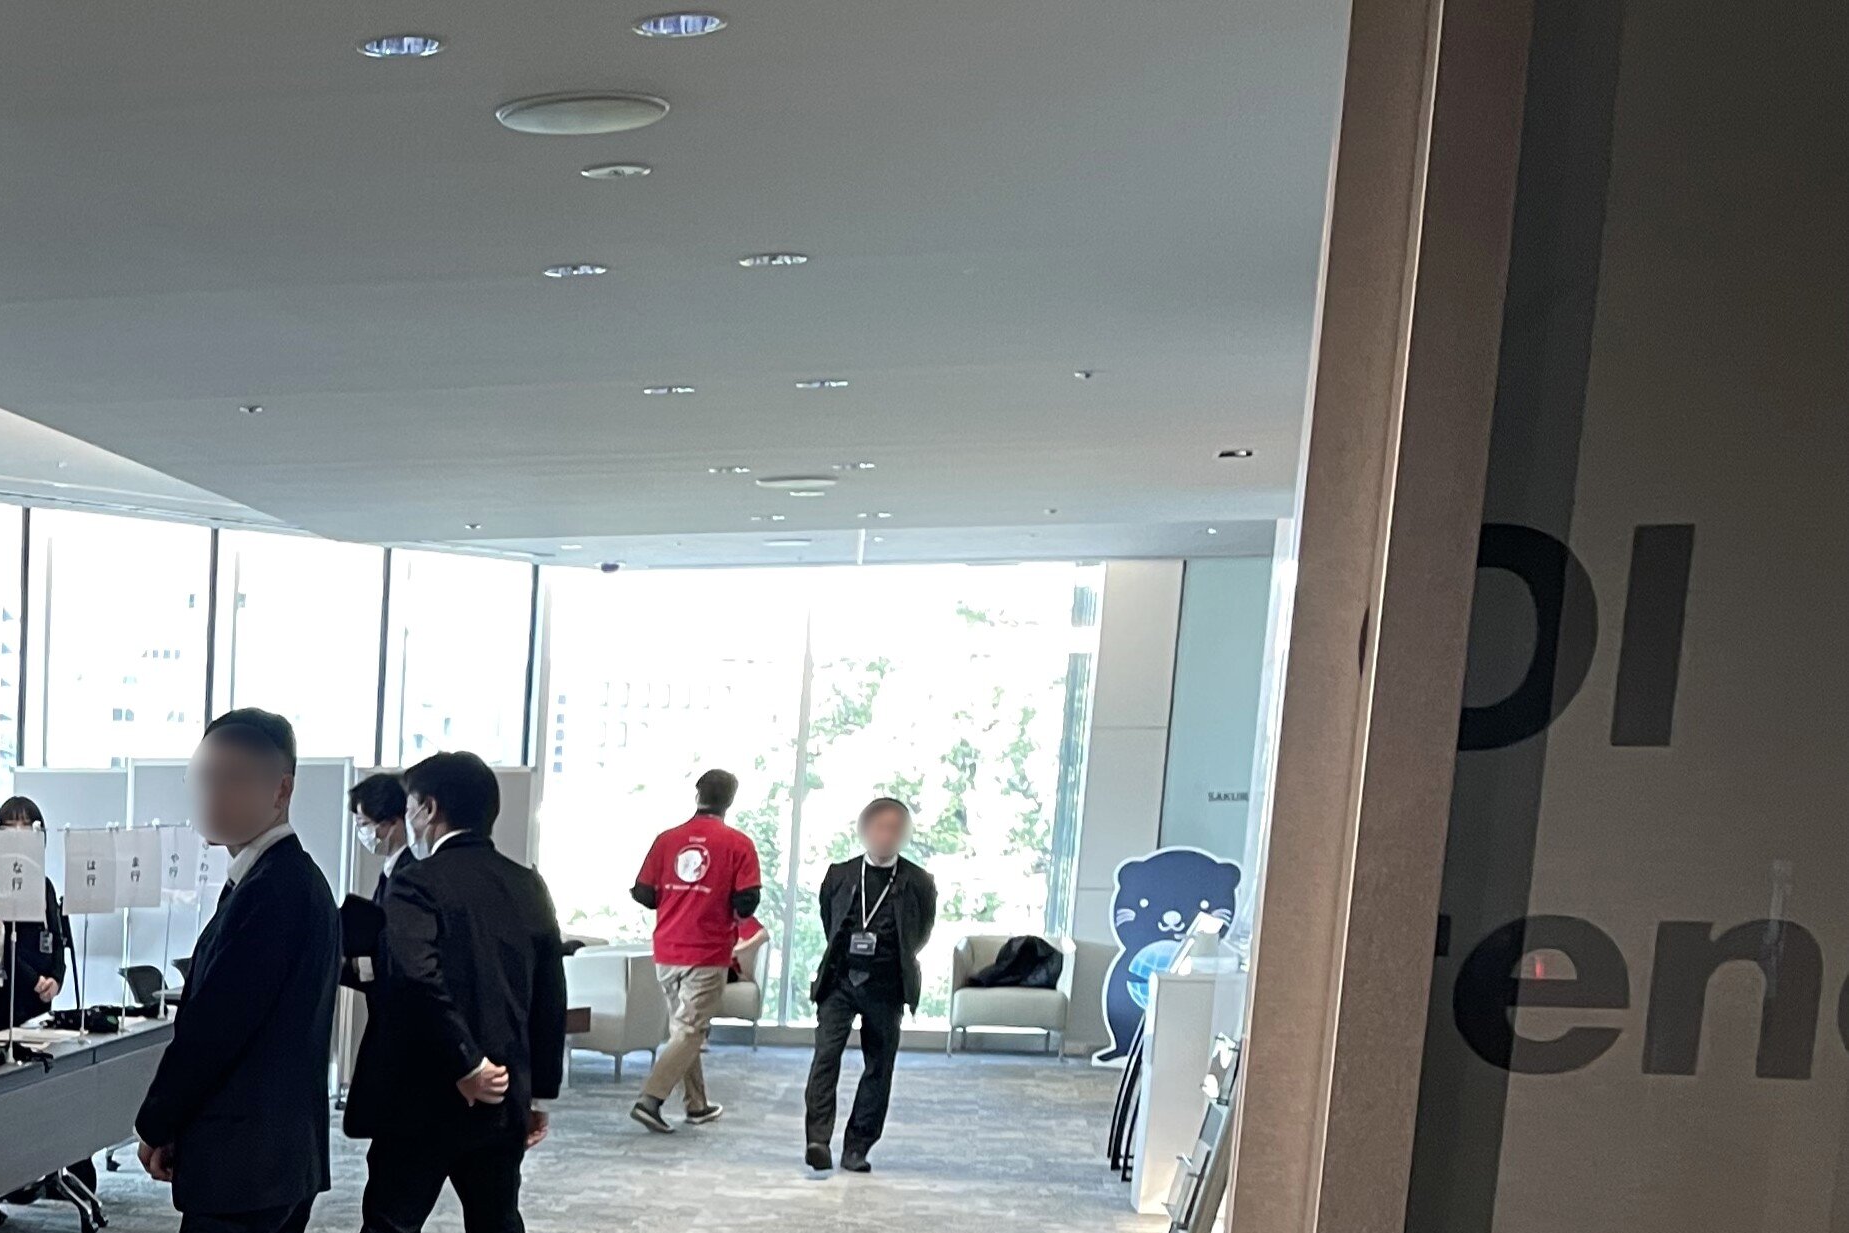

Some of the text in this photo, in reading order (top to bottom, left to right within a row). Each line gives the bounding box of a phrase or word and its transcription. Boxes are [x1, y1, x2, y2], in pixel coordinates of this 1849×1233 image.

[11, 861, 23, 891] な行
[86, 860, 97, 887] は行
[1435, 914, 1849, 1080] en
